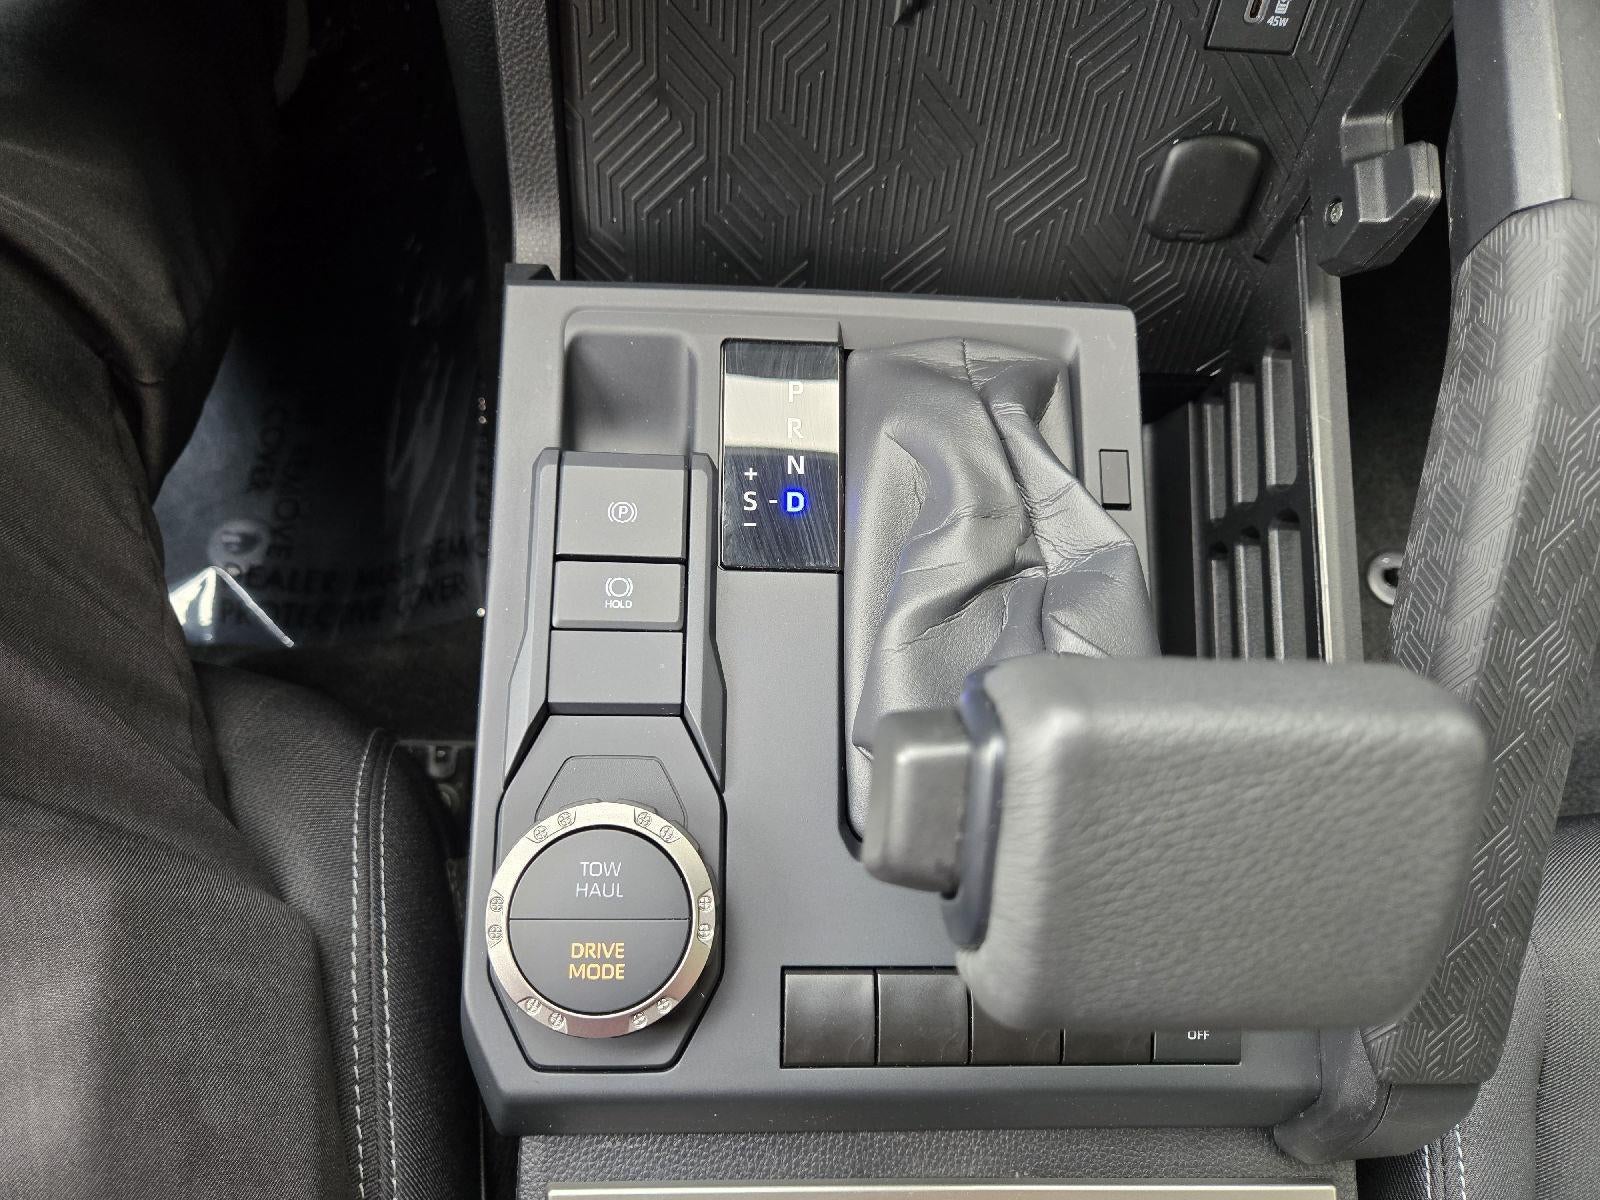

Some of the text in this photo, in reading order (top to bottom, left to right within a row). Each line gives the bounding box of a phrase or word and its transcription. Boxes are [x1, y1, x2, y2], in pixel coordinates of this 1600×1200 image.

[1266, 15, 1289, 27] 45W
[788, 381, 804, 403] P
[787, 417, 804, 439] R
[787, 455, 805, 475] N
[743, 490, 758, 511] S
[786, 491, 805, 512] D
[604, 599, 633, 609] HOLD
[579, 861, 622, 877] TOW
[575, 882, 624, 898] HAUL
[571, 942, 625, 959] DRIVE
[569, 963, 625, 981] MODE
[1187, 1030, 1210, 1040] OFF
